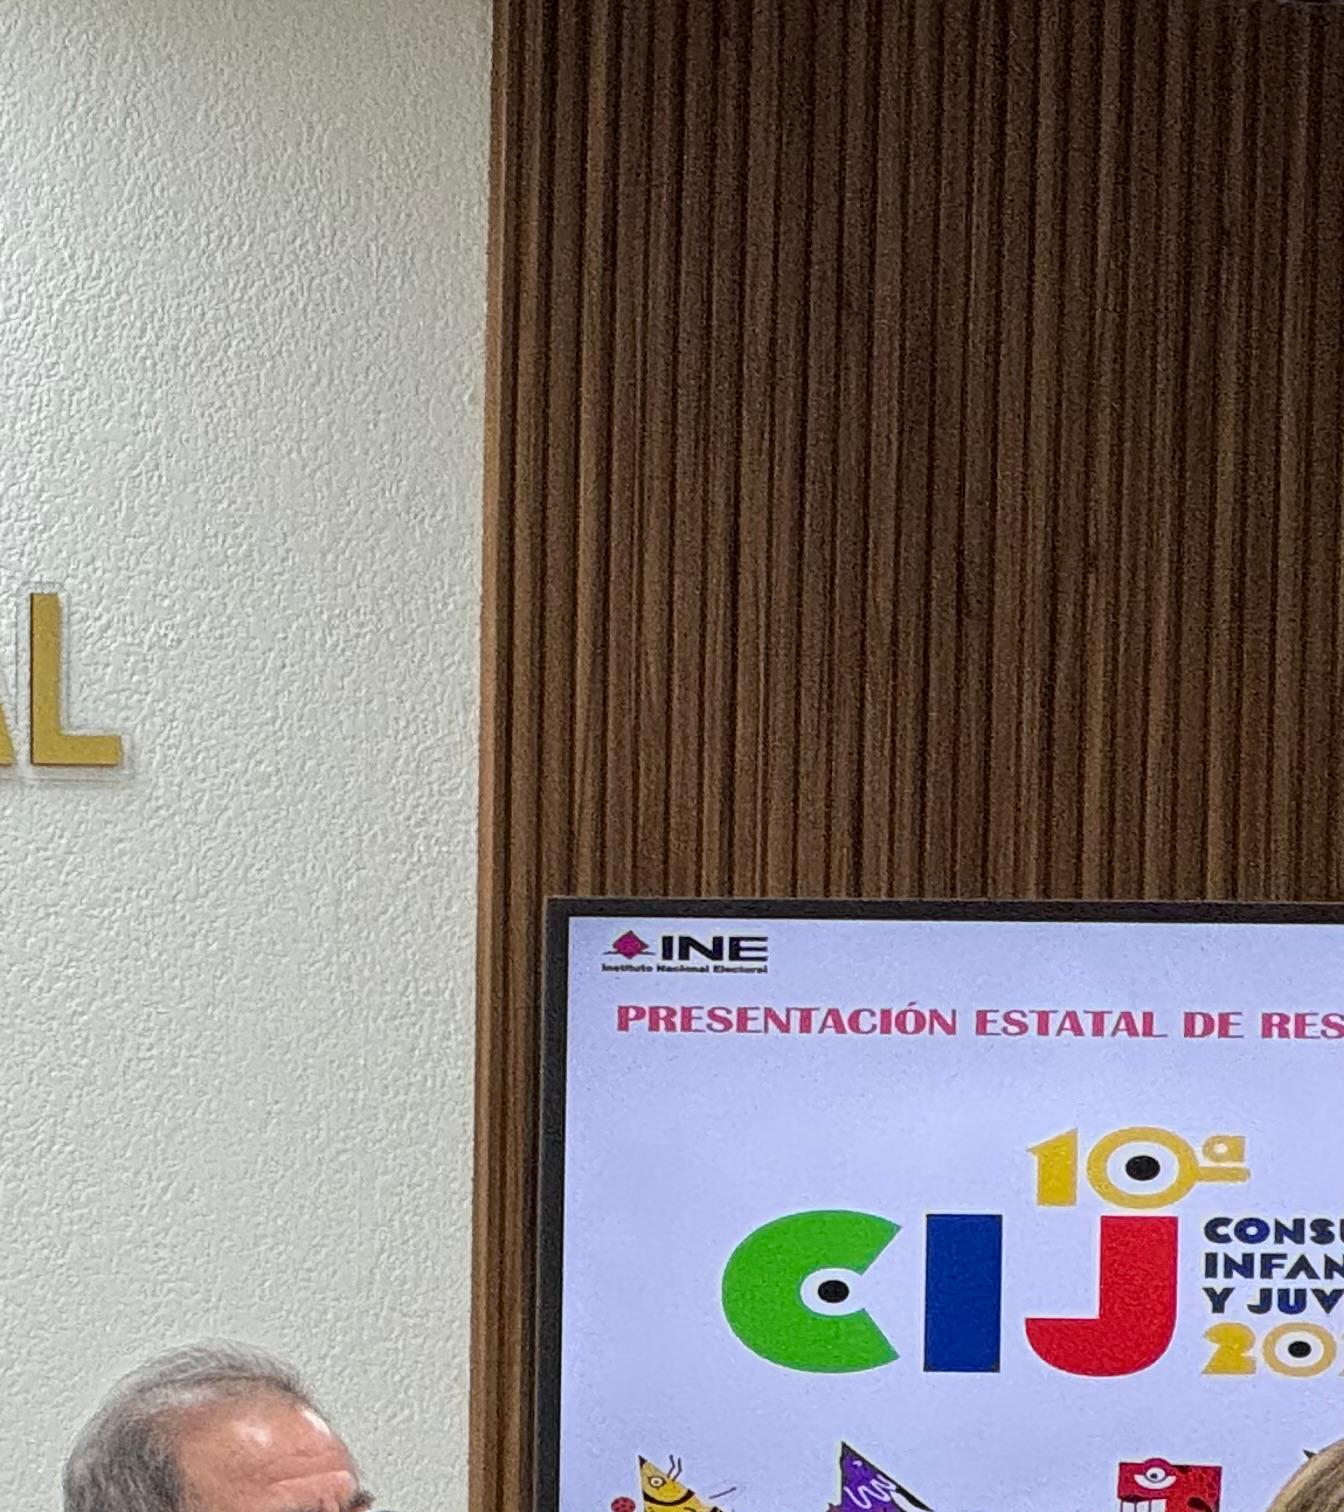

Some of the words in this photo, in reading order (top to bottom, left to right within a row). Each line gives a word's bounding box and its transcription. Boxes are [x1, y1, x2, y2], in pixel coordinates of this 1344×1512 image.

[661, 936, 769, 961] INE
[617, 1002, 956, 1036] PRESENTACIÓN
[975, 1009, 1168, 1039] ESTATAL
[1183, 1011, 1243, 1039] DE
[1261, 1012, 1344, 1040] RES
[1203, 1217, 1344, 1245] CONS
[721, 1210, 1179, 1377] CIJ
[1202, 1287, 1235, 1314] Y
[1201, 1321, 1344, 1378] 20
